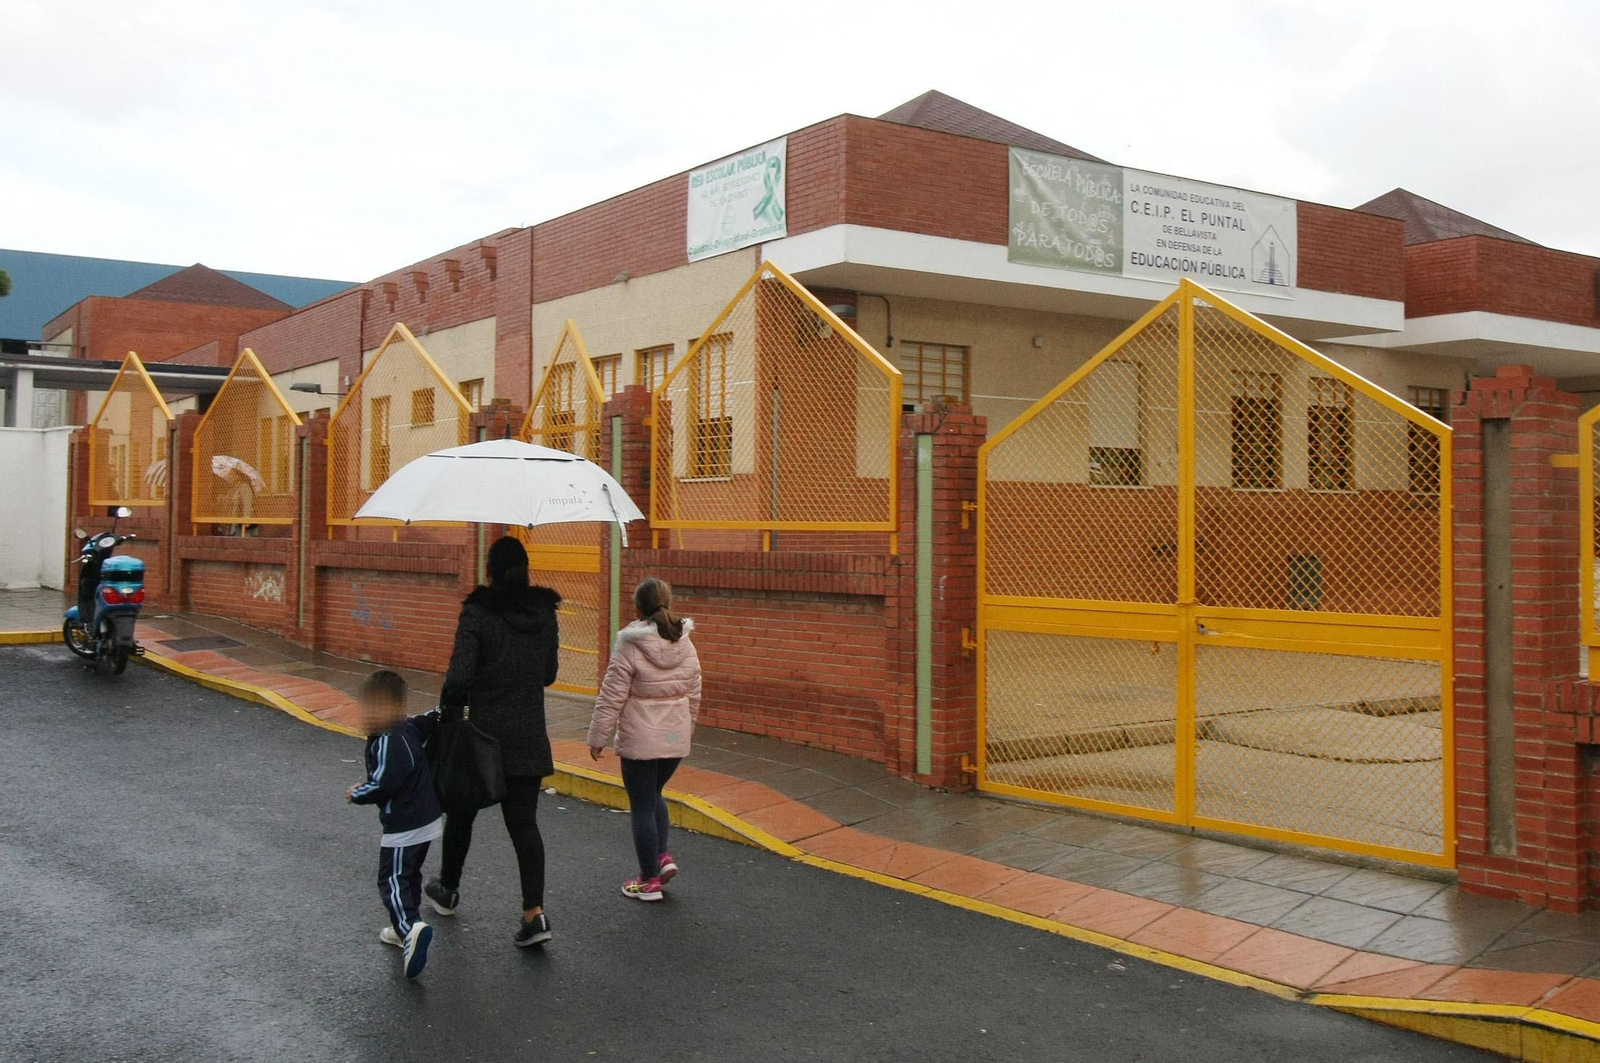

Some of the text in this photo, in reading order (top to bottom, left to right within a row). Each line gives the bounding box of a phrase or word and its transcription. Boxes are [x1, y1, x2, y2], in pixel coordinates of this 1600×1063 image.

[1130, 183, 1246, 212] LA COMUNIDAD EDUCATIVA DEL
[1030, 200, 1052, 216] DE
[1130, 200, 1246, 232] C.E.I.P. EL PUNTAL
[1016, 230, 1062, 253] PARA
[1162, 224, 1217, 241] DE BELLAVISTA
[1156, 238, 1222, 256] EN DEFENSA DE LA
[1131, 251, 1246, 280] EDUCACIÓN PÚBLICA
[548, 496, 582, 506] impala
